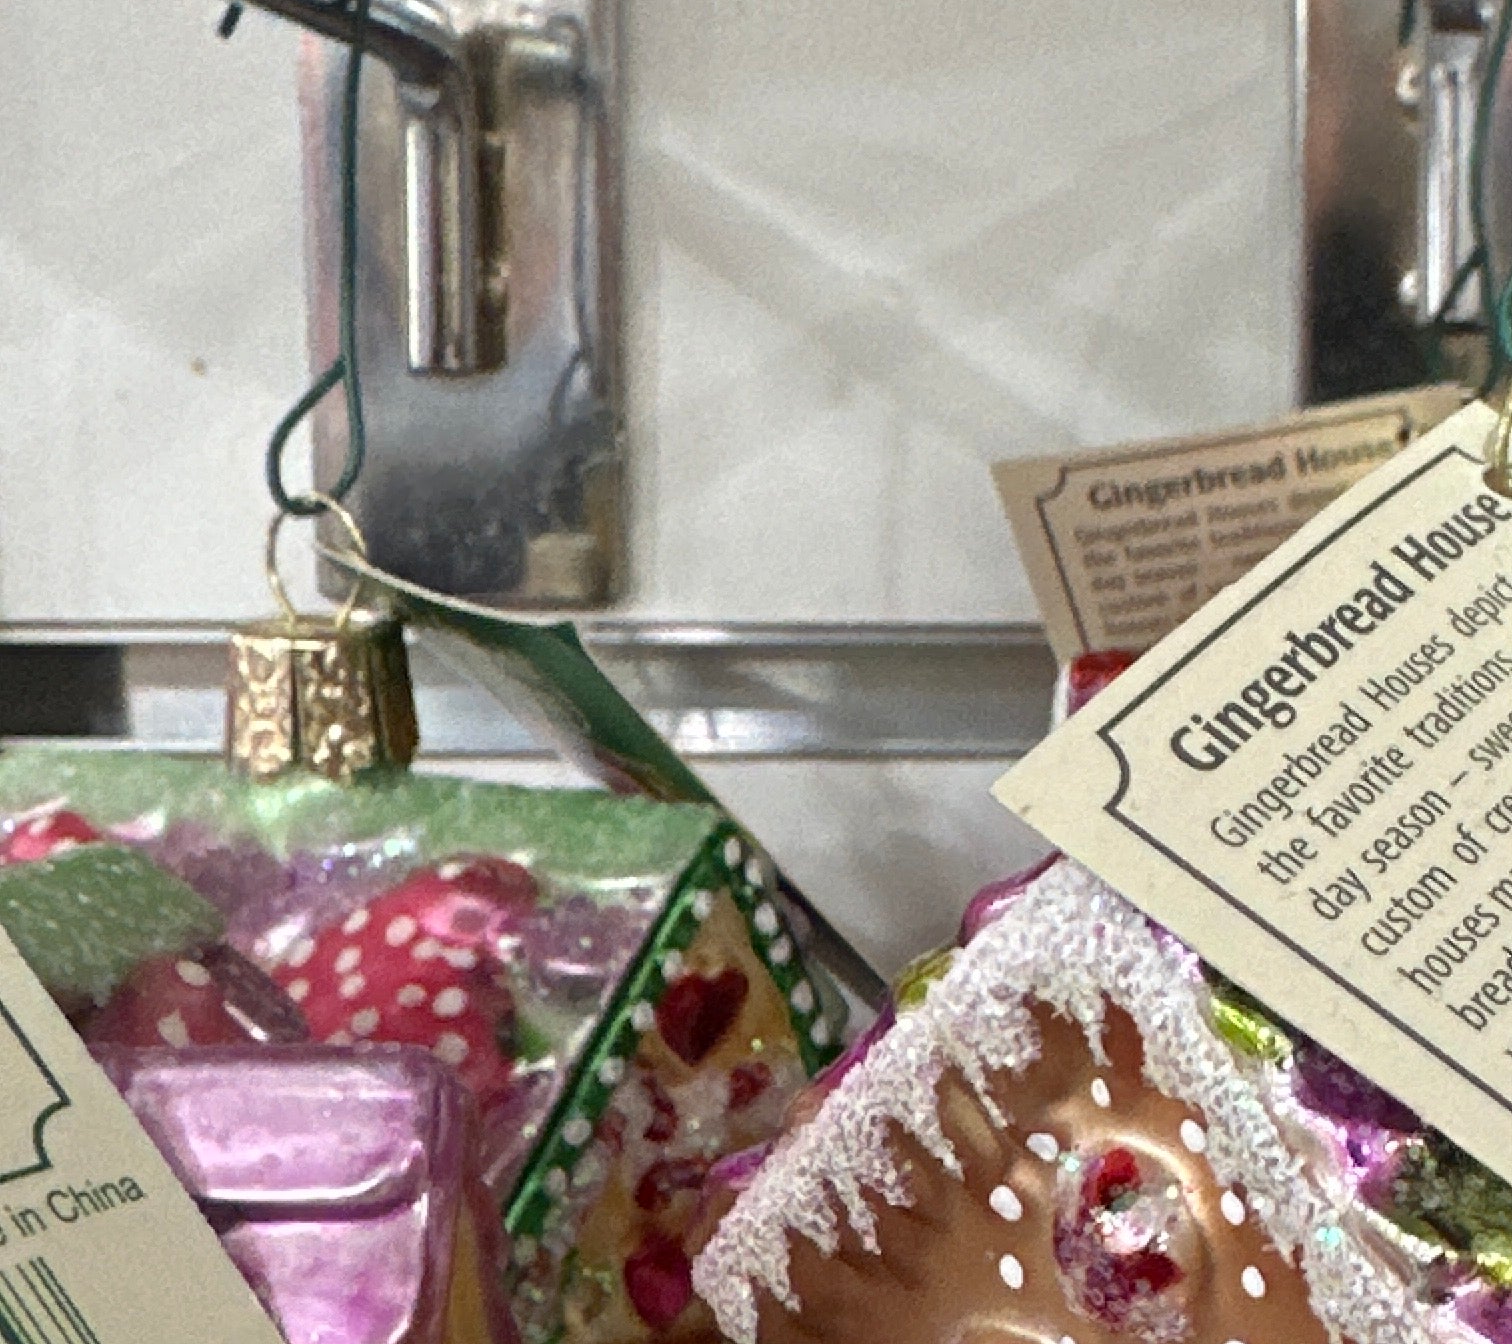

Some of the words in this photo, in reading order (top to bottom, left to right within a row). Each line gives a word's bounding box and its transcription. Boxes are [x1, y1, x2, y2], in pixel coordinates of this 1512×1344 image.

[1168, 559, 1416, 772] Gingerbread
[1209, 700, 1374, 848] Gingerbread
[1357, 633, 1456, 712] Houses
[1256, 837, 1319, 885] the
[1304, 746, 1414, 838] favorite
[1306, 866, 1372, 921] day
[1359, 789, 1452, 874] season
[1359, 865, 1458, 956] custom
[1451, 821, 1489, 865] of
[1395, 902, 1500, 996] houses
[3, 1203, 48, 1239] in
[45, 1175, 148, 1224] China
